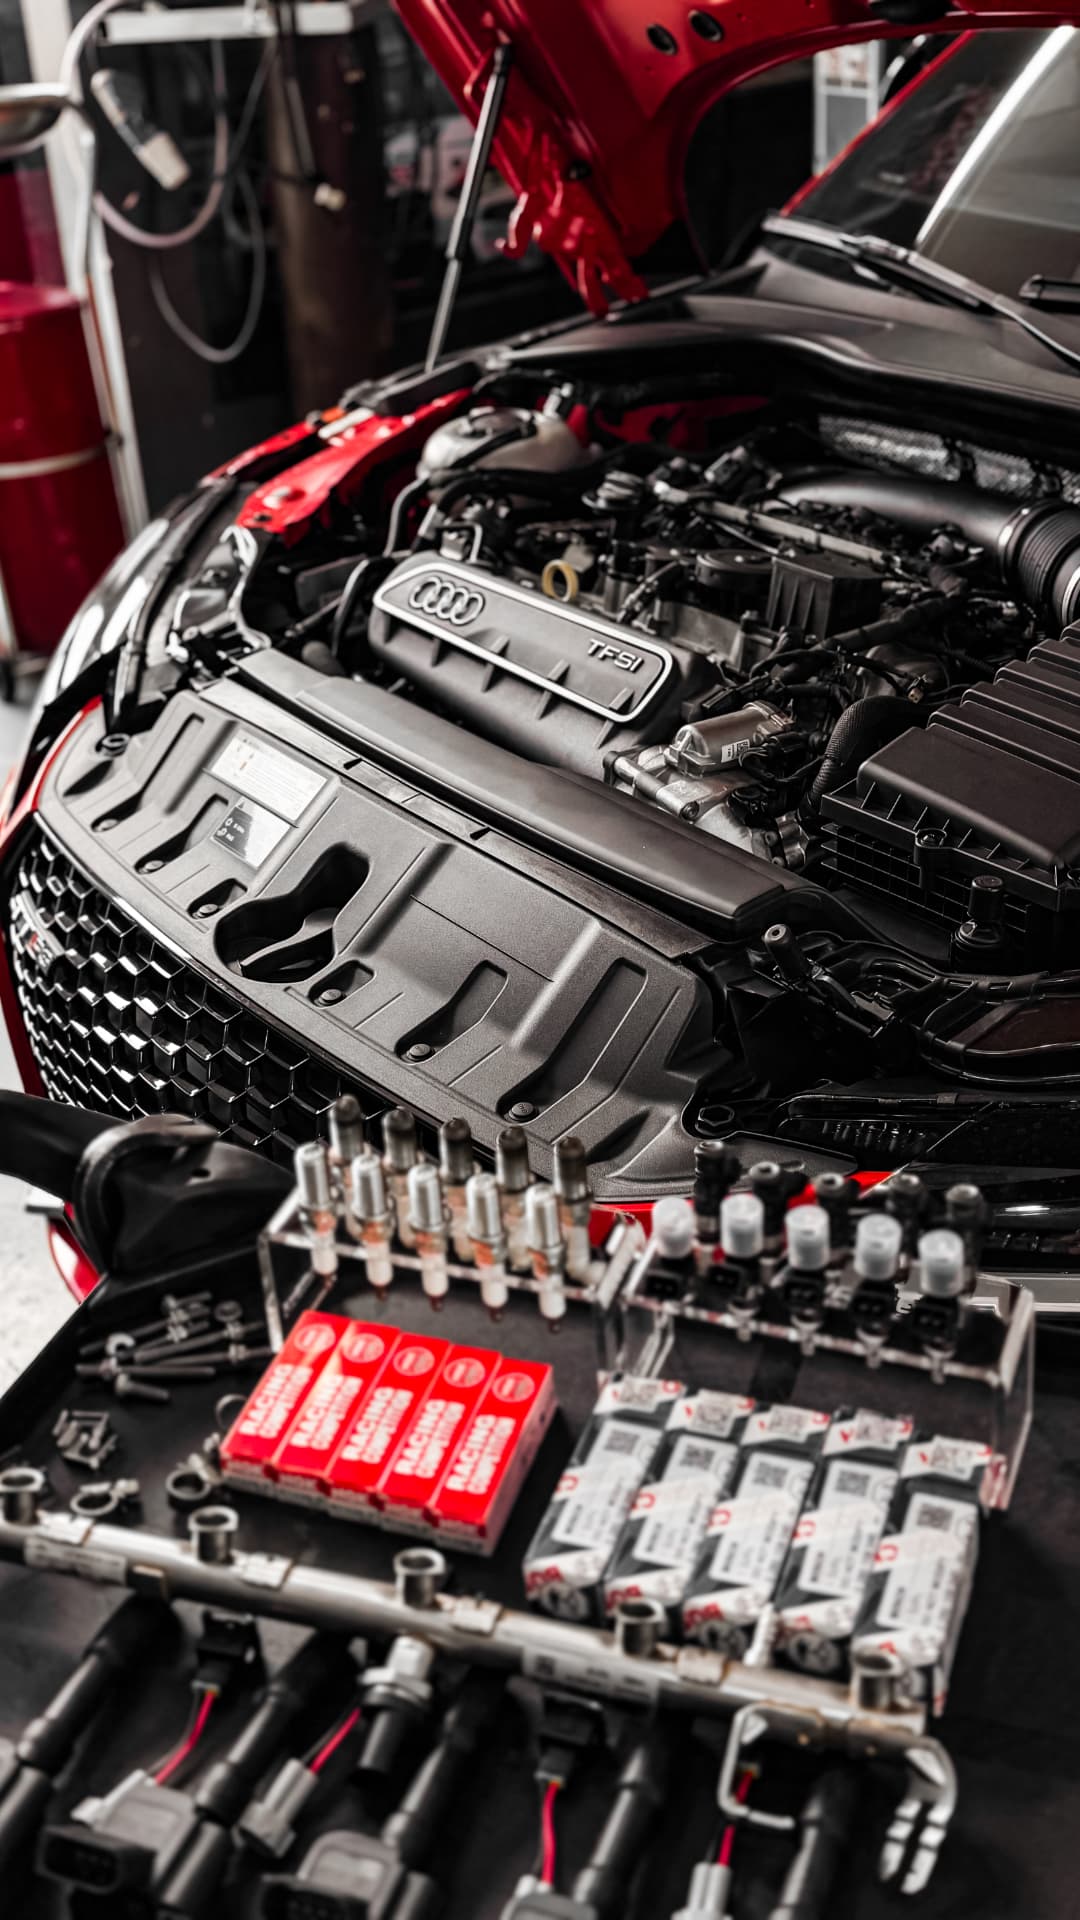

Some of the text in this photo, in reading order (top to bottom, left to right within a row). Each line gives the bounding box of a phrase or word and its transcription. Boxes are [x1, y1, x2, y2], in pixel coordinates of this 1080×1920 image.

[588, 639, 644, 672] TFSI
[238, 1363, 294, 1435] RACING
[339, 1386, 395, 1460] RACING
[391, 1399, 446, 1474] RACING
[443, 1416, 496, 1490] RACING
